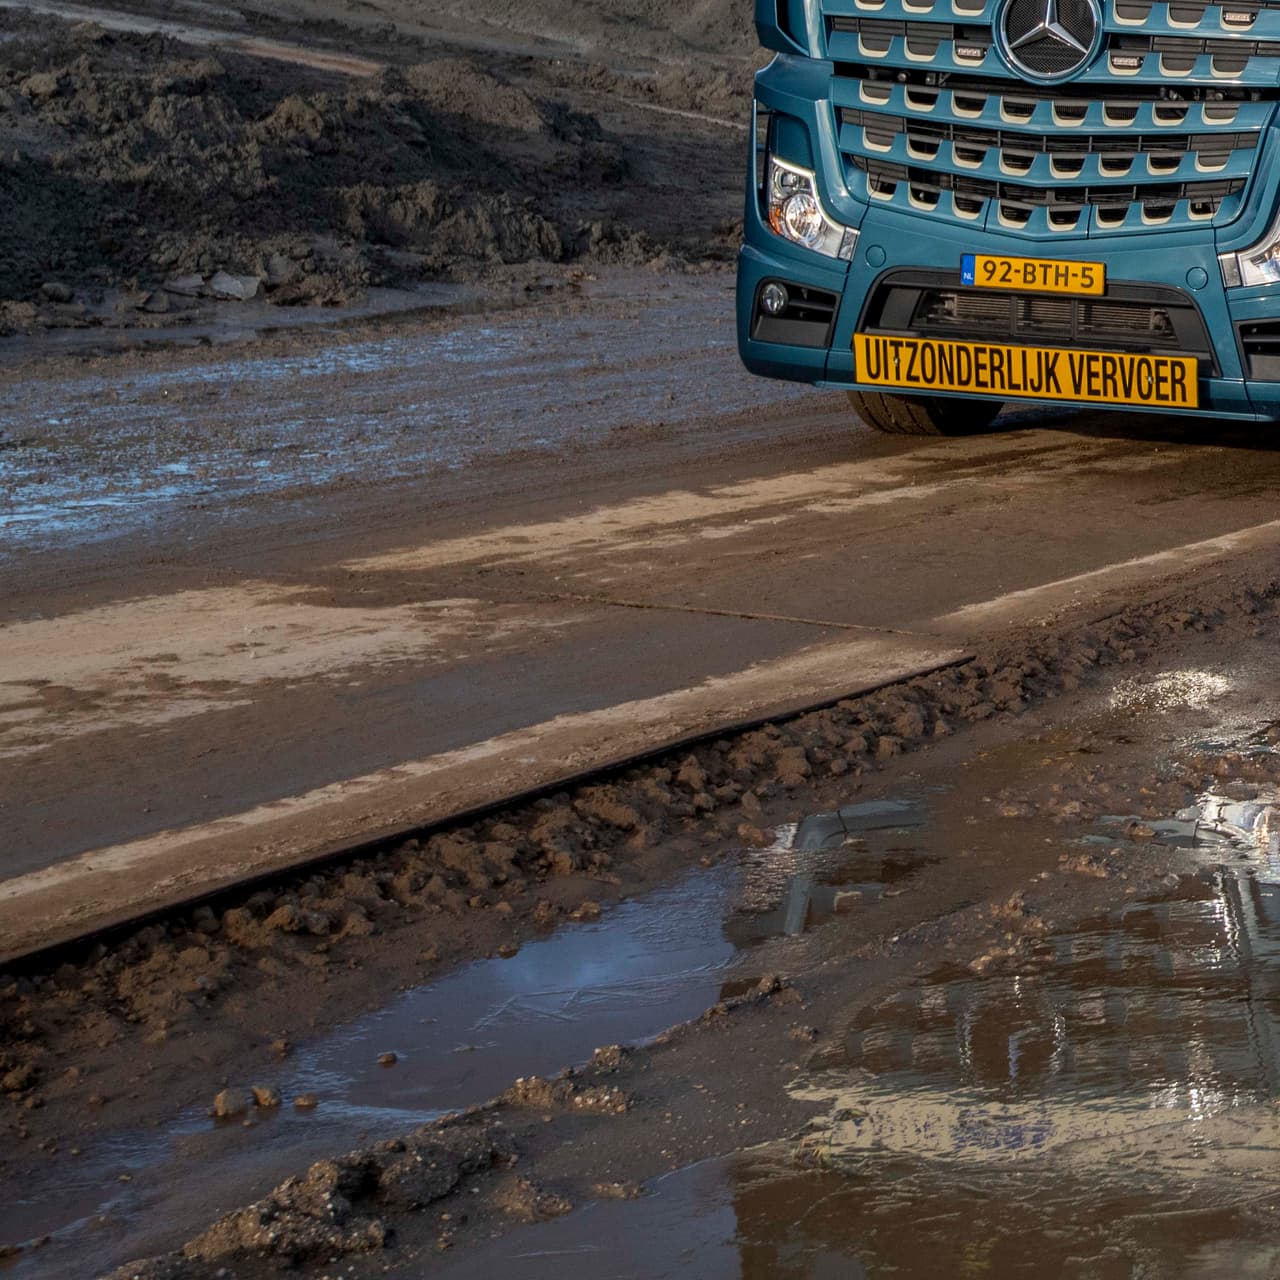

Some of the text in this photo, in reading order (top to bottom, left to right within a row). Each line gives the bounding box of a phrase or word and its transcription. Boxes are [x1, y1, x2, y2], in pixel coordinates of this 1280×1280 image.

[963, 271, 974, 281] NL
[982, 259, 1095, 289] 92-BTH-5
[864, 337, 1188, 403] UITZONDERLIJK VERVOER
